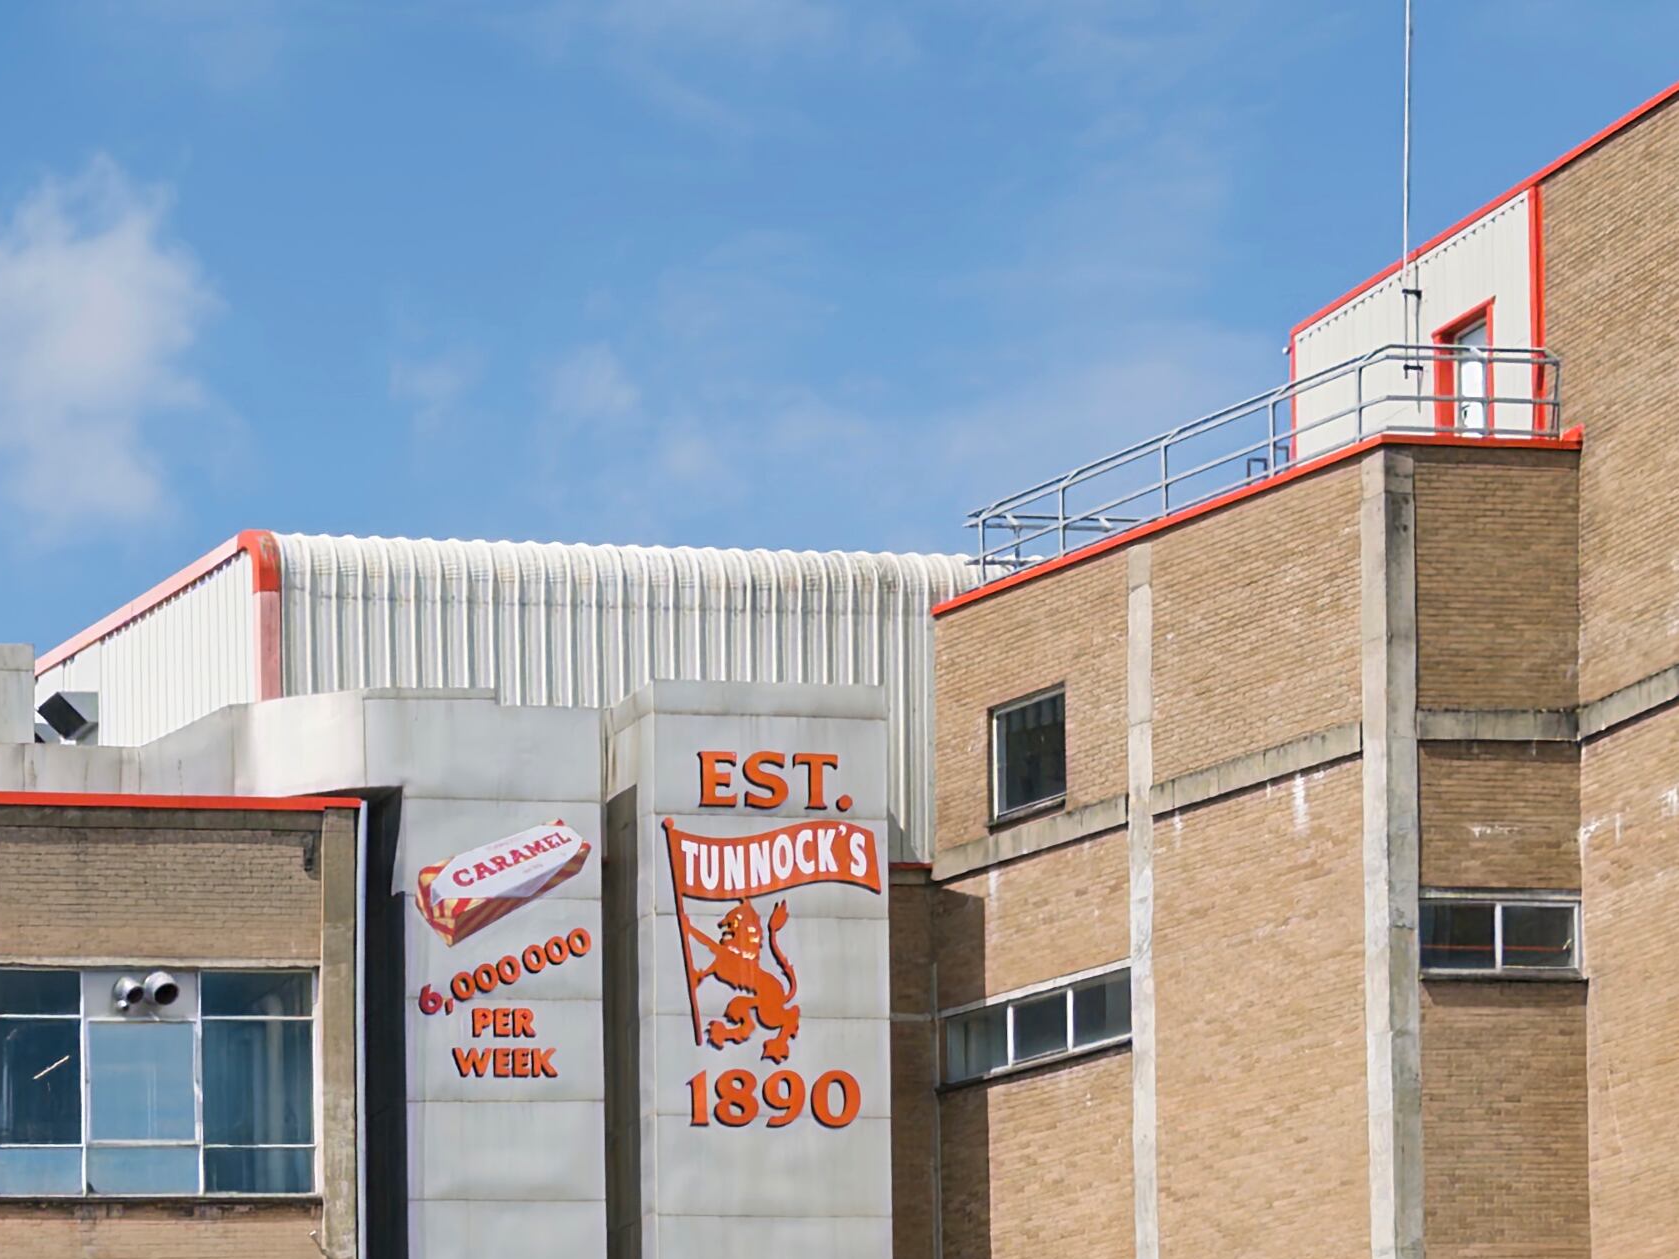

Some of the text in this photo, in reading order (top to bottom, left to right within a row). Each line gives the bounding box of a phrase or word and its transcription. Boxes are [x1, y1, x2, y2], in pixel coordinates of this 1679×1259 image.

[697, 751, 853, 812] EST.
[452, 832, 572, 887] CARAMEL
[681, 824, 867, 891] TUNNOCK'S
[472, 1007, 536, 1038] PER
[452, 1047, 558, 1078] WEEK
[686, 1069, 862, 1128] 1890
